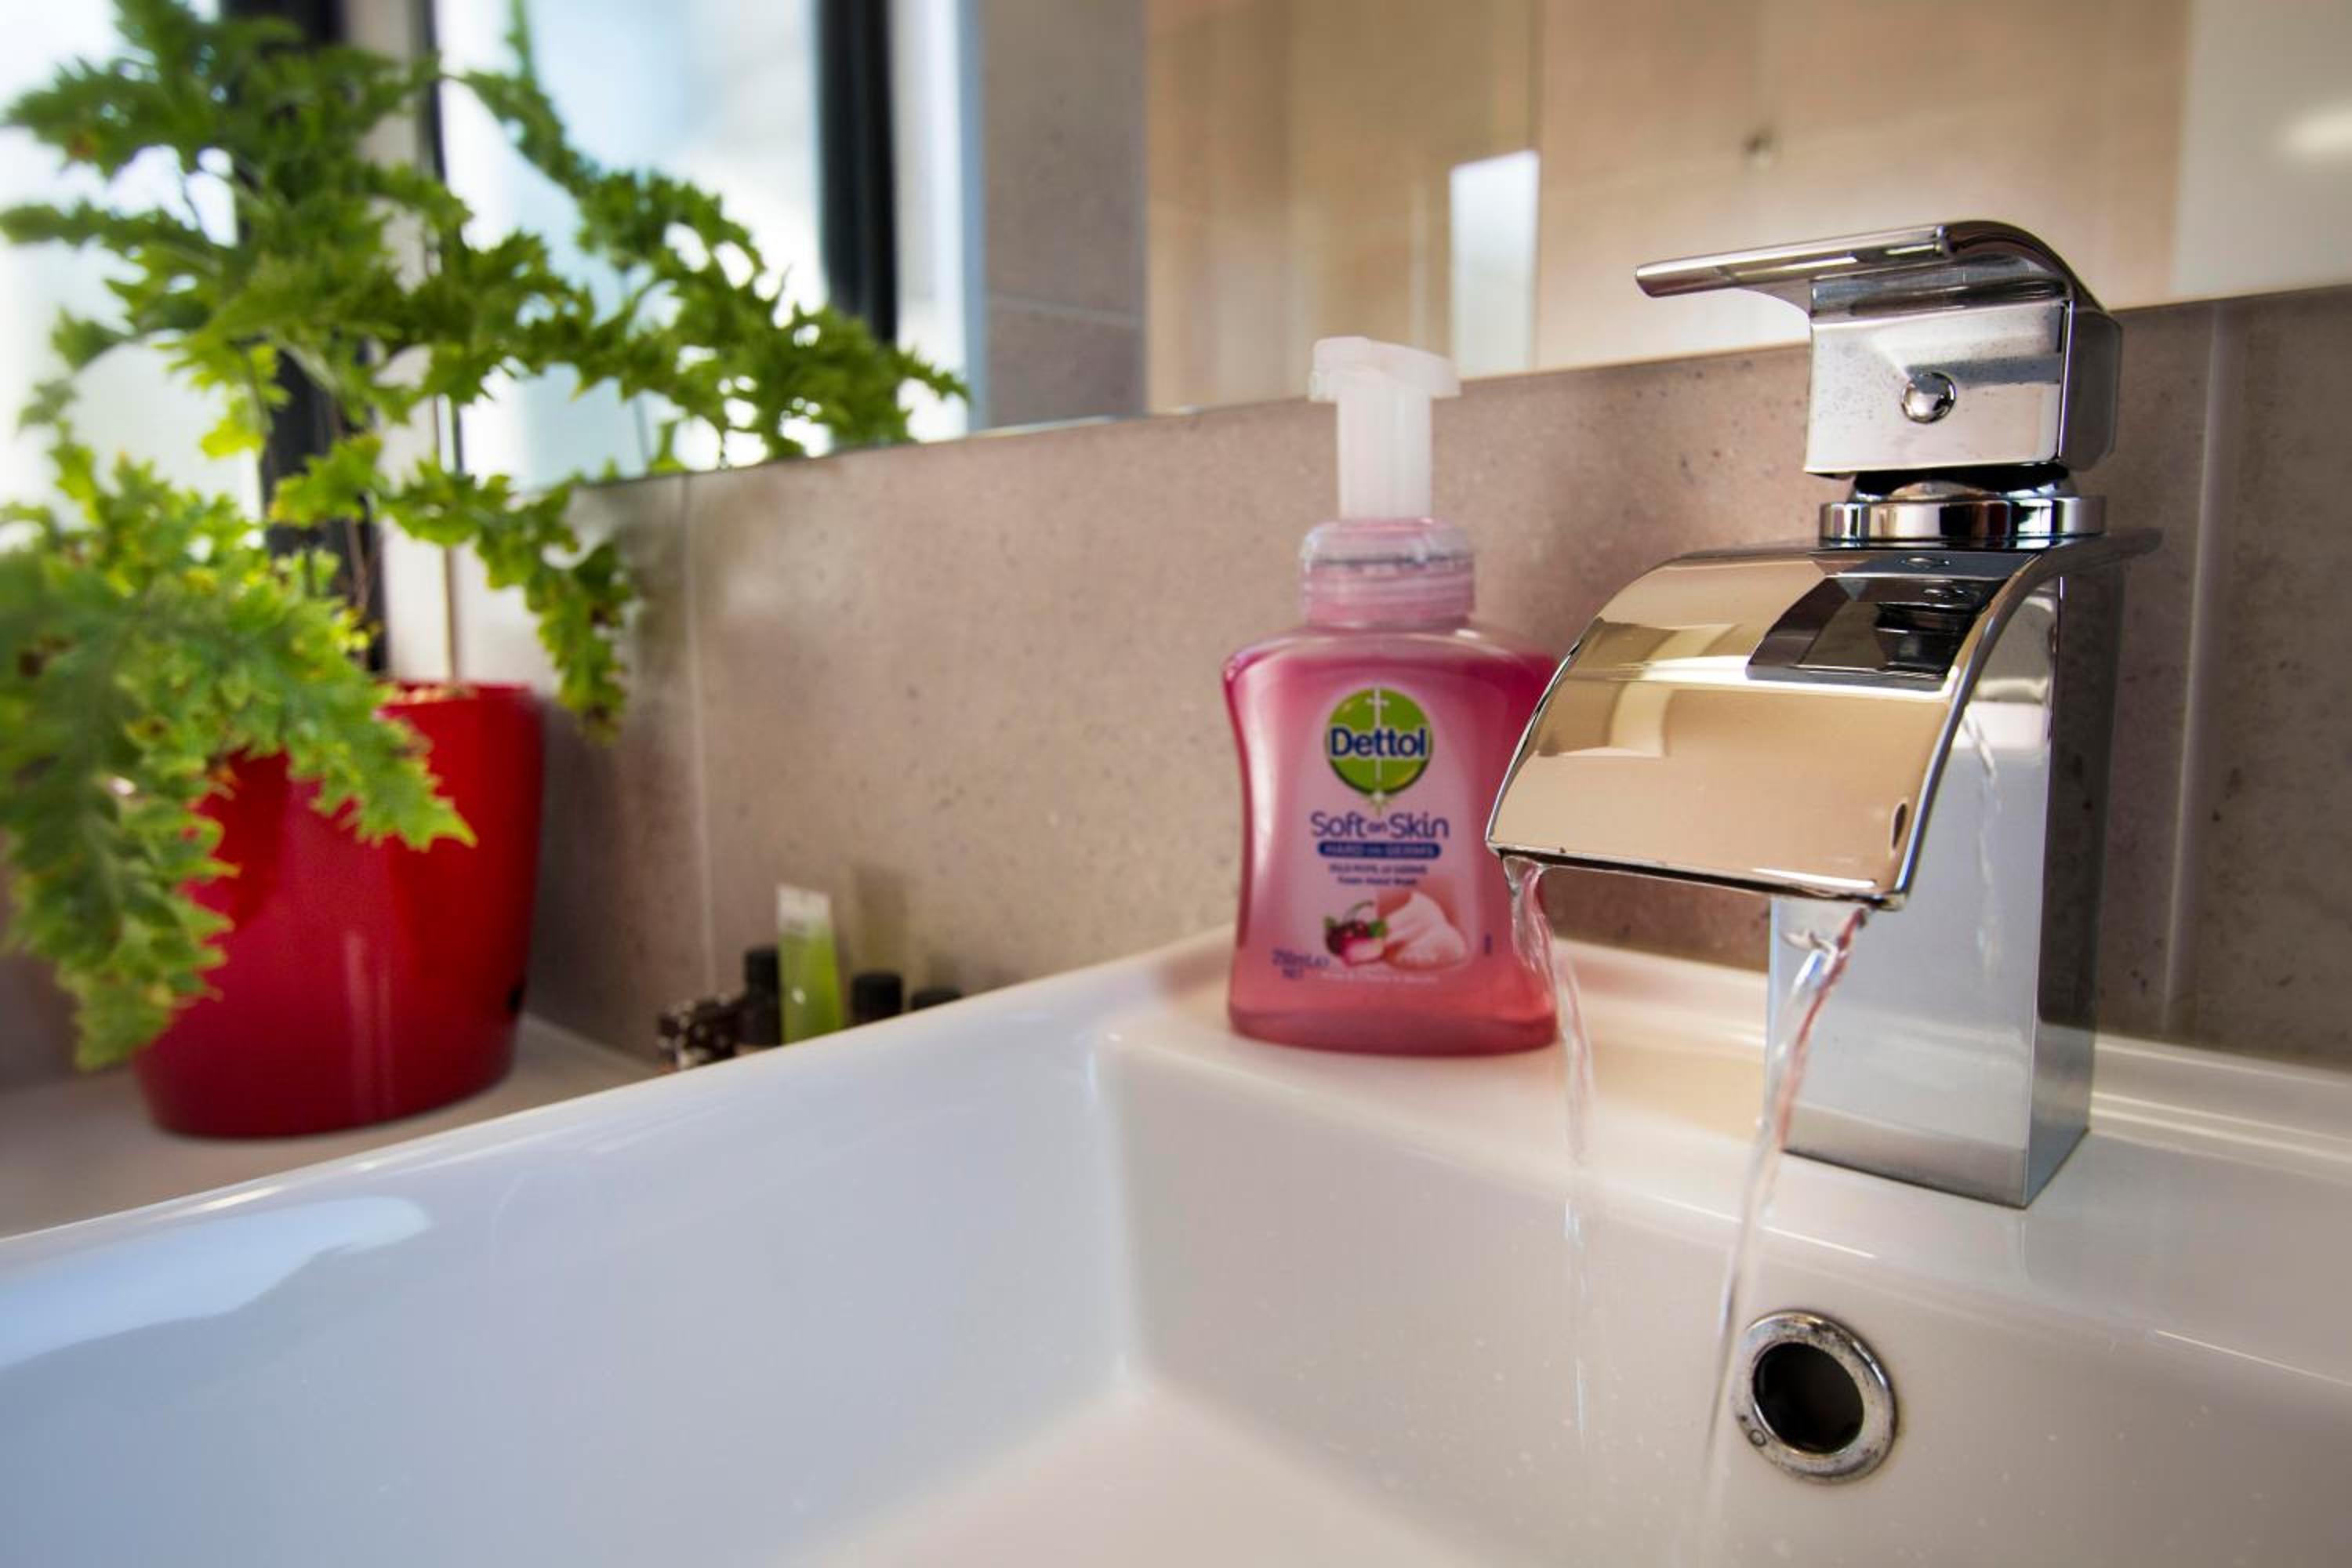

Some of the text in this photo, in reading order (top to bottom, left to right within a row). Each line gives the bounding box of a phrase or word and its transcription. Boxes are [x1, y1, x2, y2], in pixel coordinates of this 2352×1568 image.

[1331, 728, 1425, 757] Dettol
[1311, 811, 1365, 837] Soft
[1389, 811, 1449, 839] Skin
